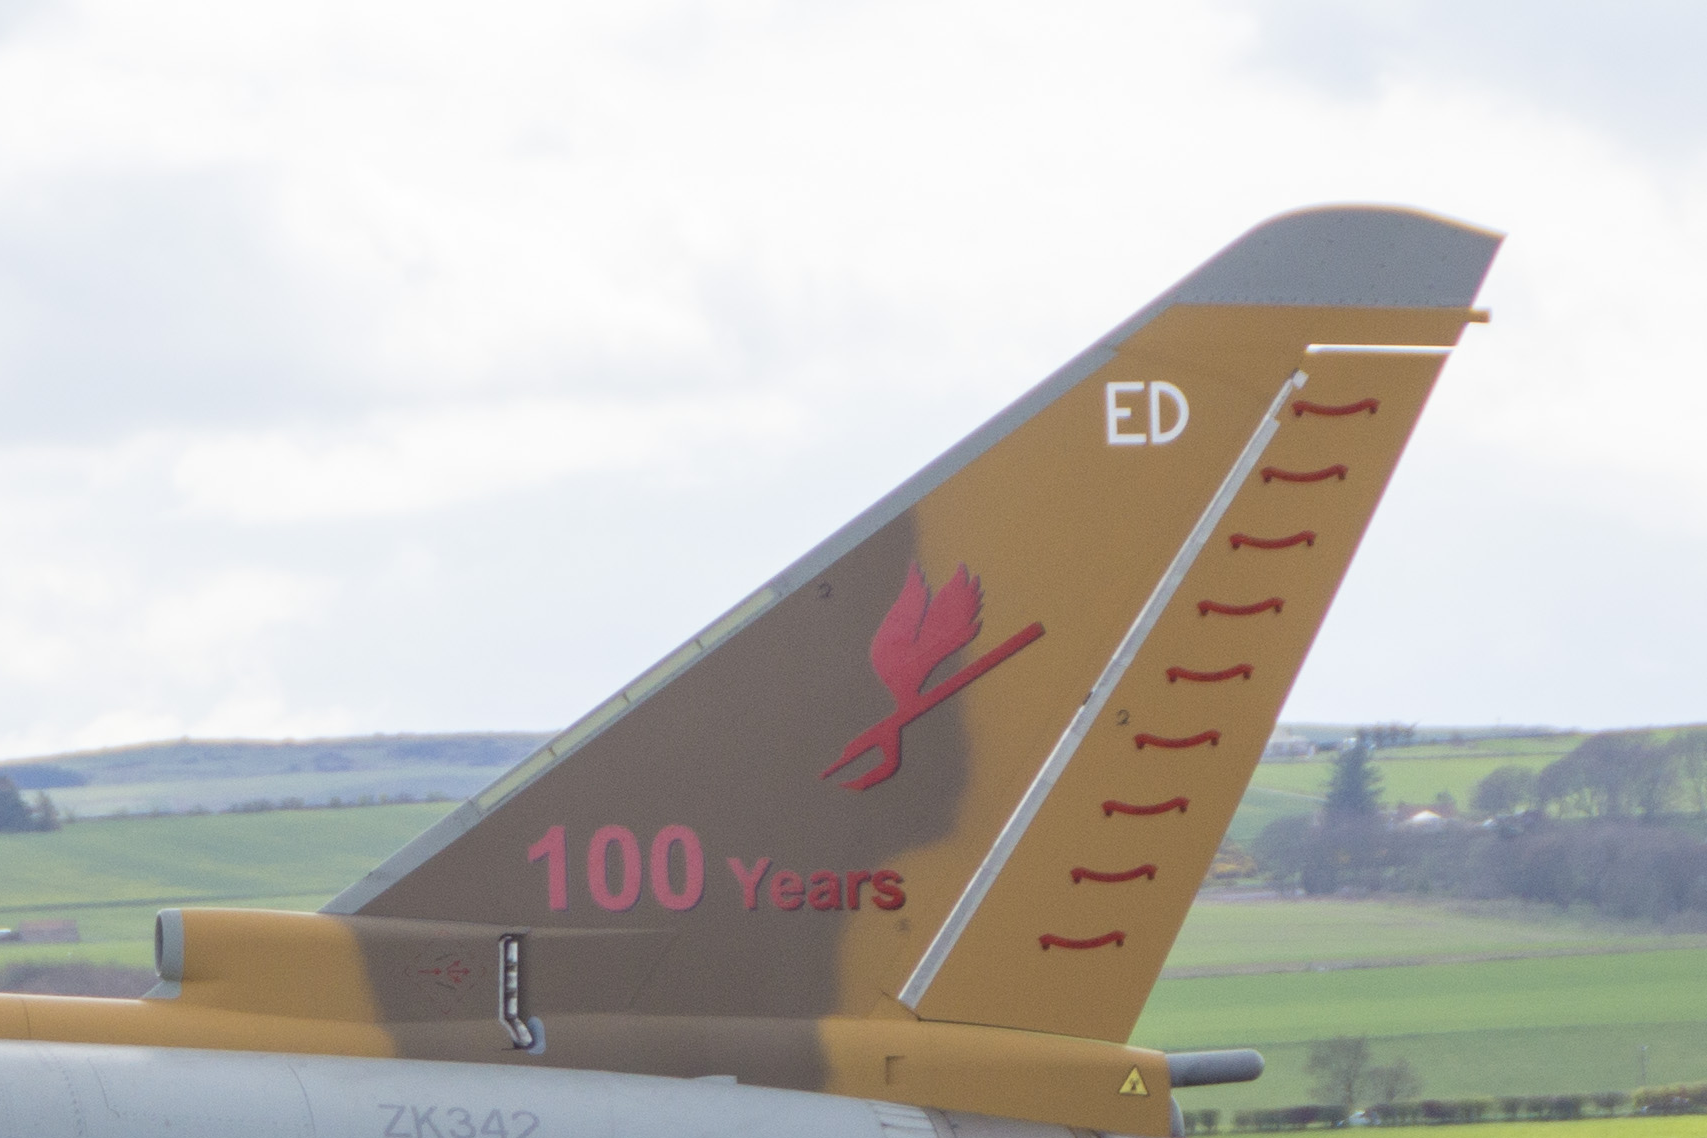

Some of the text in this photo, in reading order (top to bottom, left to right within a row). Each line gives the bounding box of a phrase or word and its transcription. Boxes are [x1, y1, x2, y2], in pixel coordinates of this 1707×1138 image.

[1106, 381, 1189, 444] ED
[527, 824, 907, 912] 100 Years
